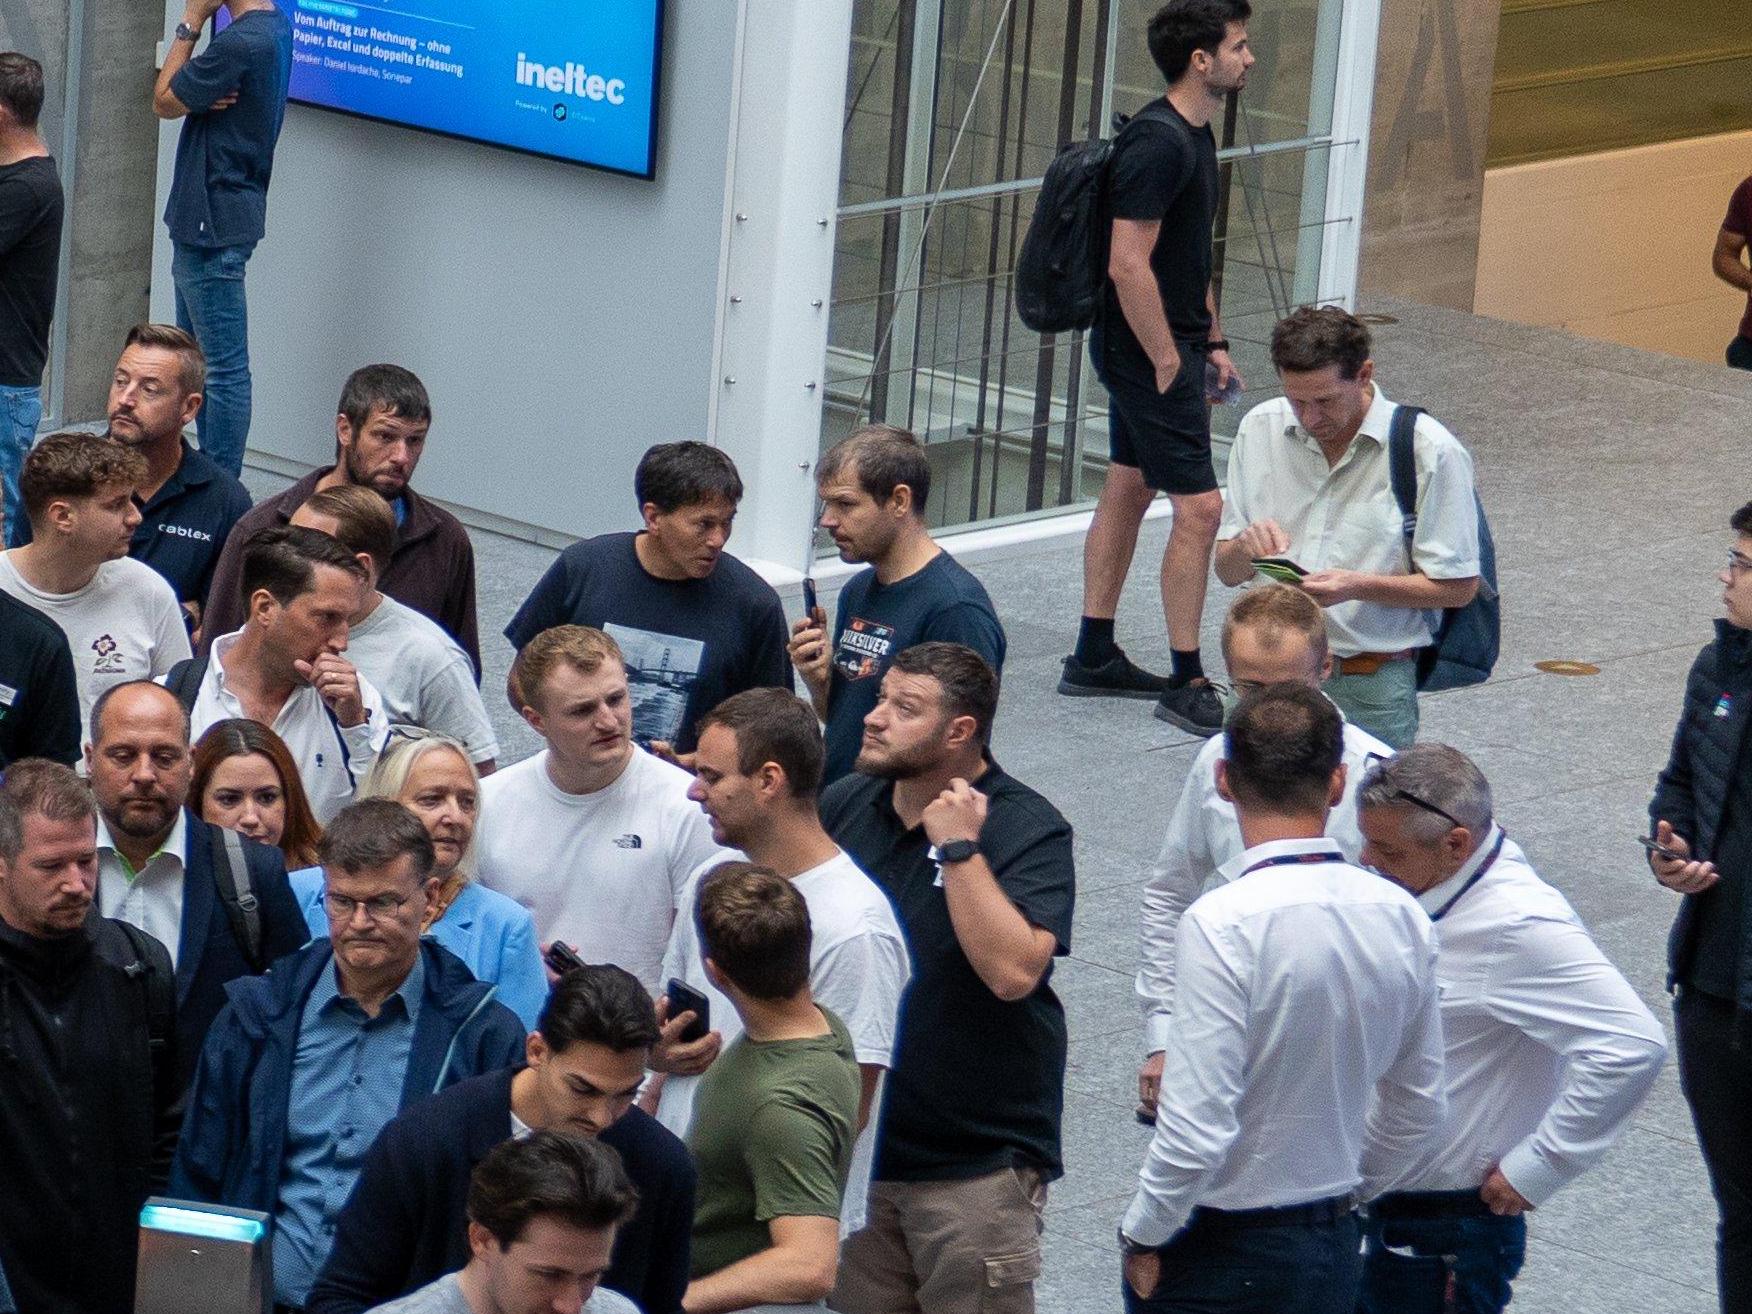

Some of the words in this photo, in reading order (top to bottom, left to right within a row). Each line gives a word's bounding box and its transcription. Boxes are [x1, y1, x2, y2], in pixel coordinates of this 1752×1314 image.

[293, 11, 314, 28] Vom
[316, 15, 352, 38] Auftrag
[353, 24, 368, 37] zur
[370, 27, 417, 52] Rechnung
[426, 39, 451, 56] ohne
[327, 35, 352, 52] Excel
[352, 39, 371, 57] und
[372, 43, 414, 66] doppelte
[415, 52, 464, 79] Erfassung
[516, 51, 625, 106] ineltec
[156, 523, 212, 542] cablex
